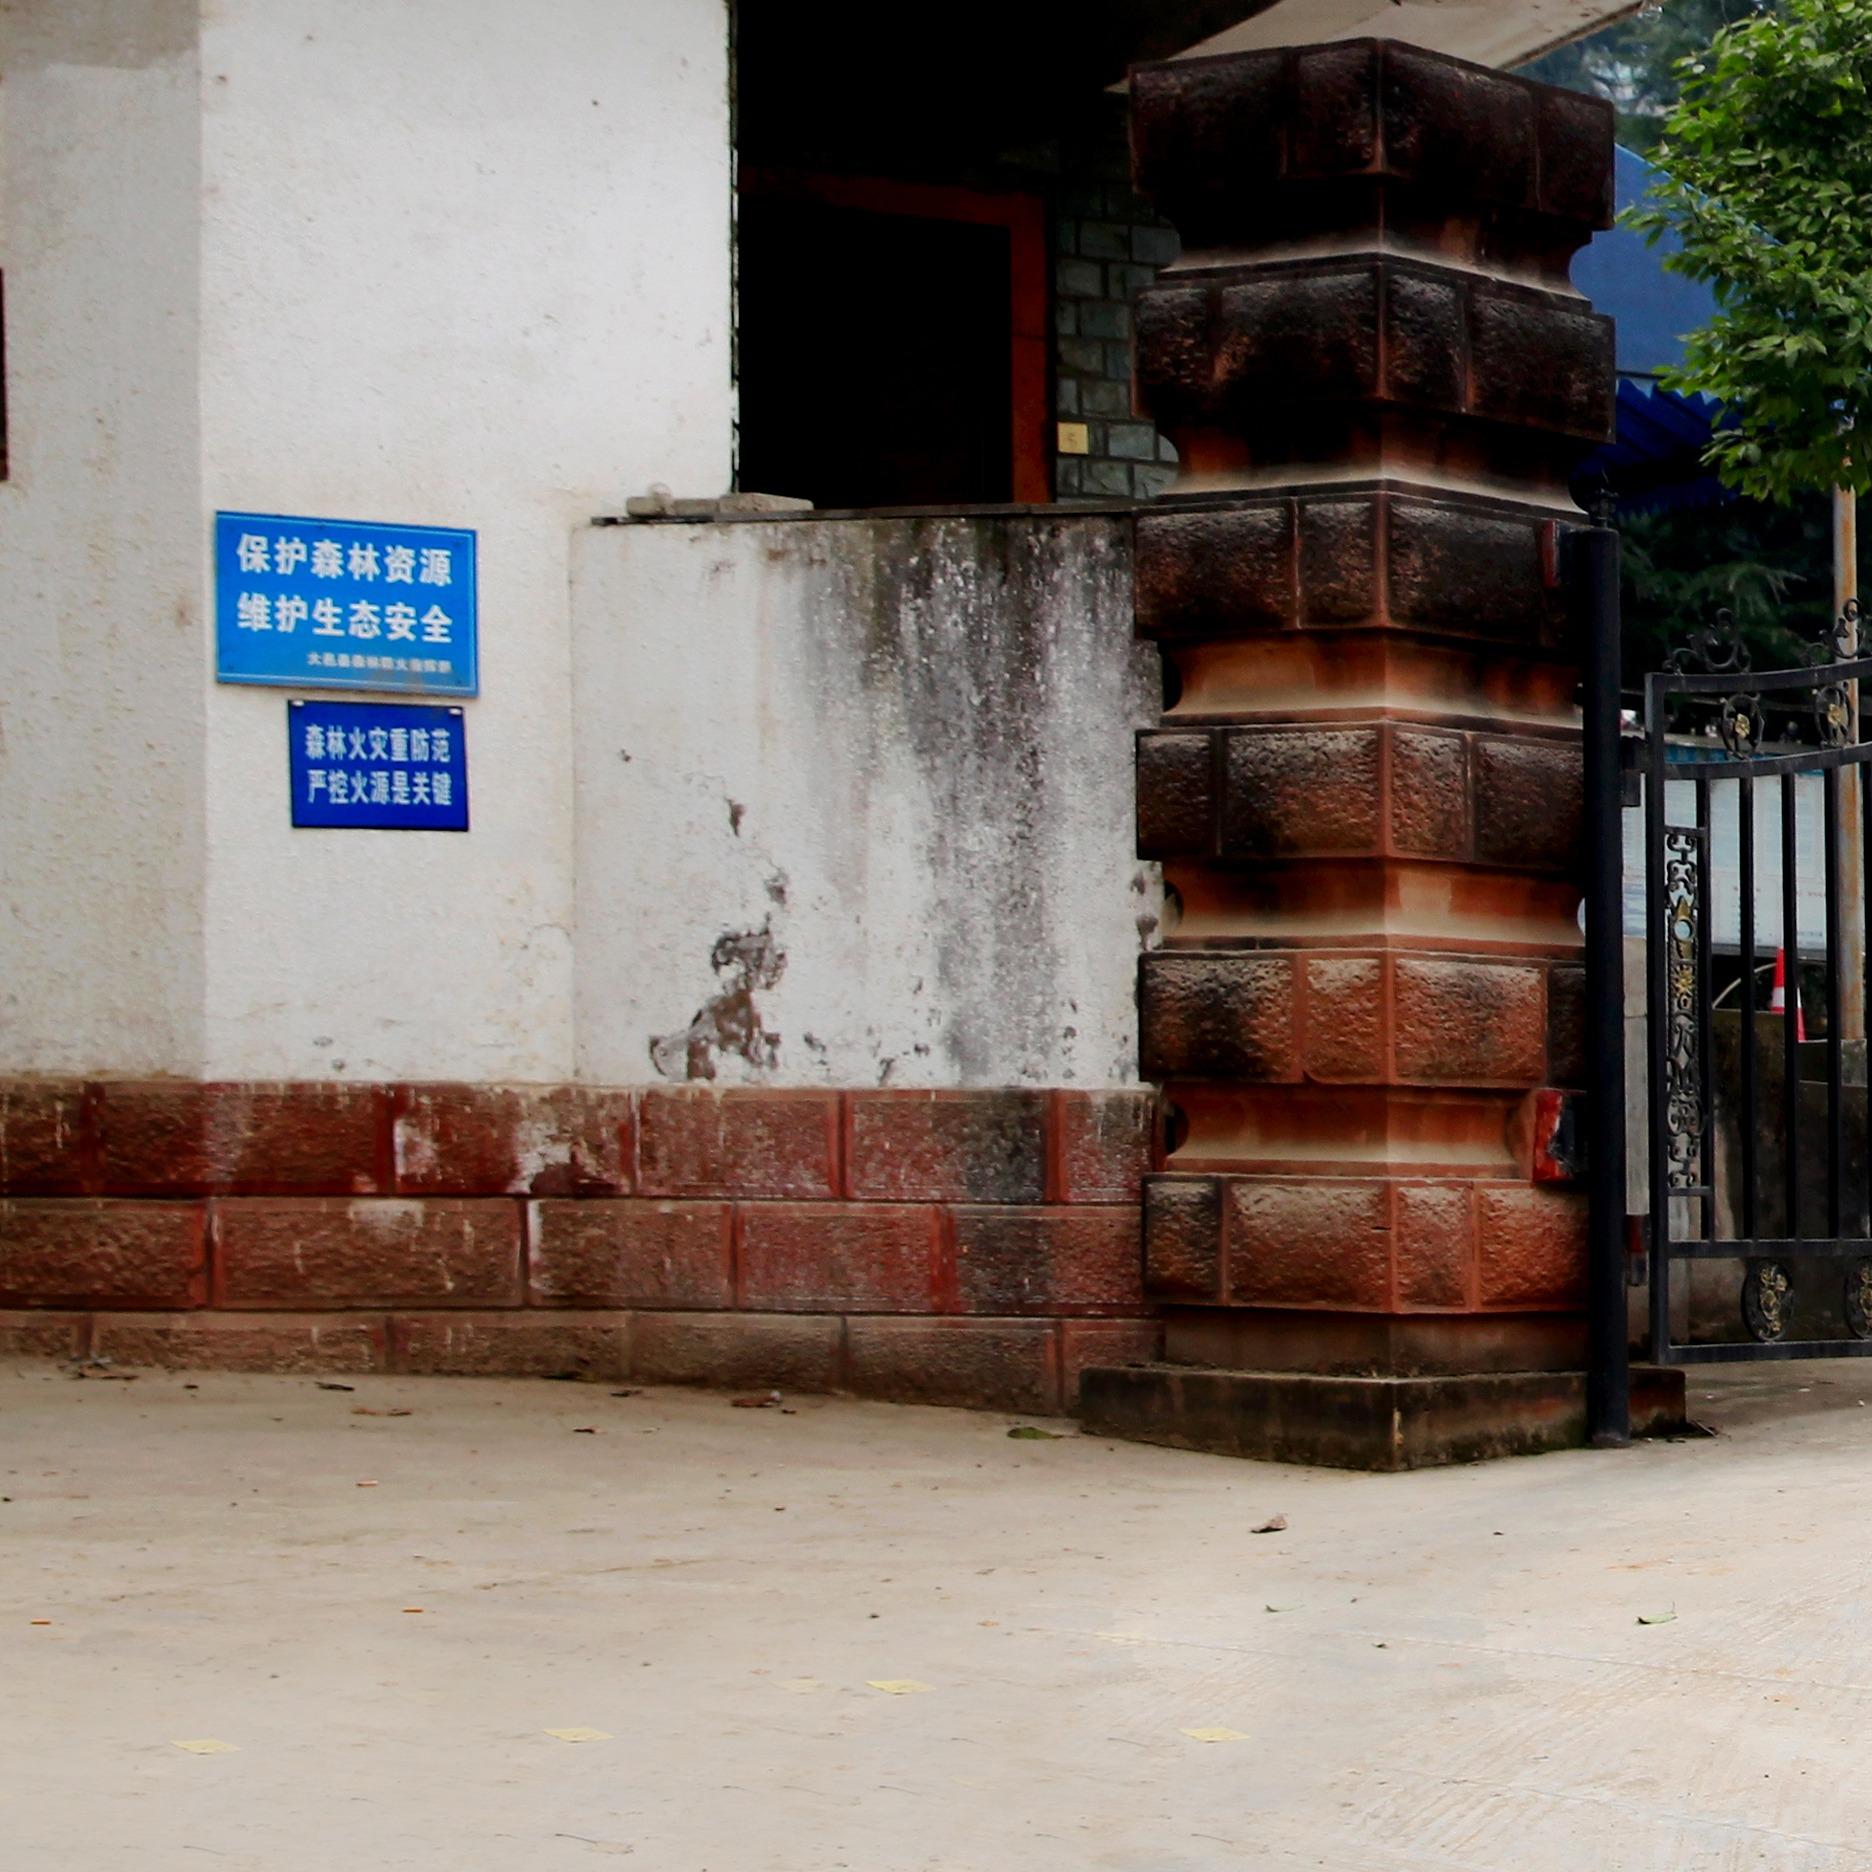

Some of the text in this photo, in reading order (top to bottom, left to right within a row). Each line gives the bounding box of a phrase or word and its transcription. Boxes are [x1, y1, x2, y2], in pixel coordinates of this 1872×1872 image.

[237, 533, 453, 586] 保护森林资源
[237, 592, 453, 643] 维护生态安全
[304, 724, 452, 763] 森林火灾重防范
[307, 769, 453, 806] 严控火源是关键
